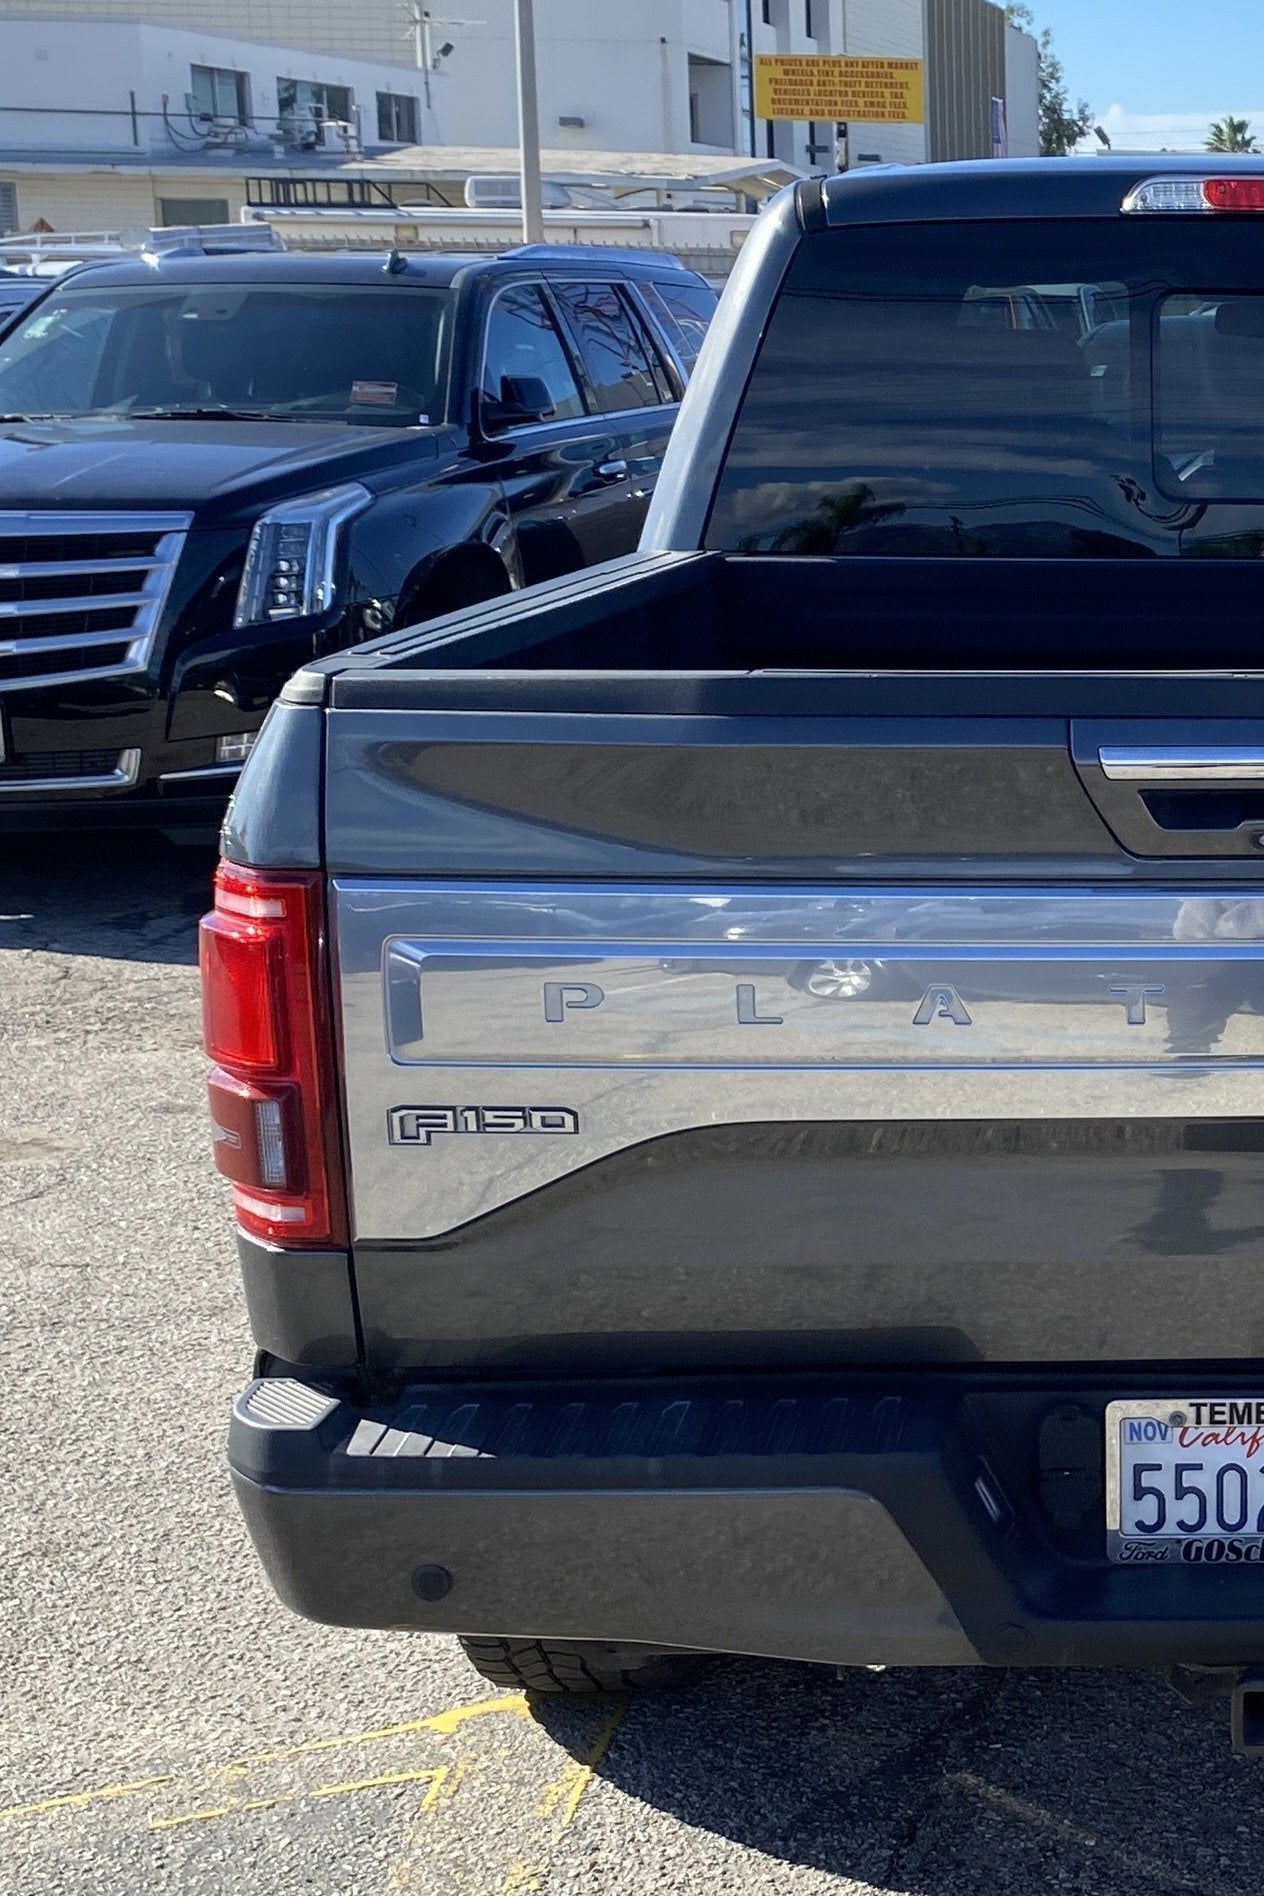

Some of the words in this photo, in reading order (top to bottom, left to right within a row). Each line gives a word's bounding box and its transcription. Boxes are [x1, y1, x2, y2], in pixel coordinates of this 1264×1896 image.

[774, 58, 802, 67] PRICES
[822, 59, 842, 68] PLUS
[844, 60, 859, 68] ANY
[862, 61, 885, 69] AFTER
[887, 61, 918, 70] MARKET
[387, 1105, 579, 1145] F150
[1128, 1422, 1168, 1442] NOV
[1119, 1541, 1169, 1561] Ford
